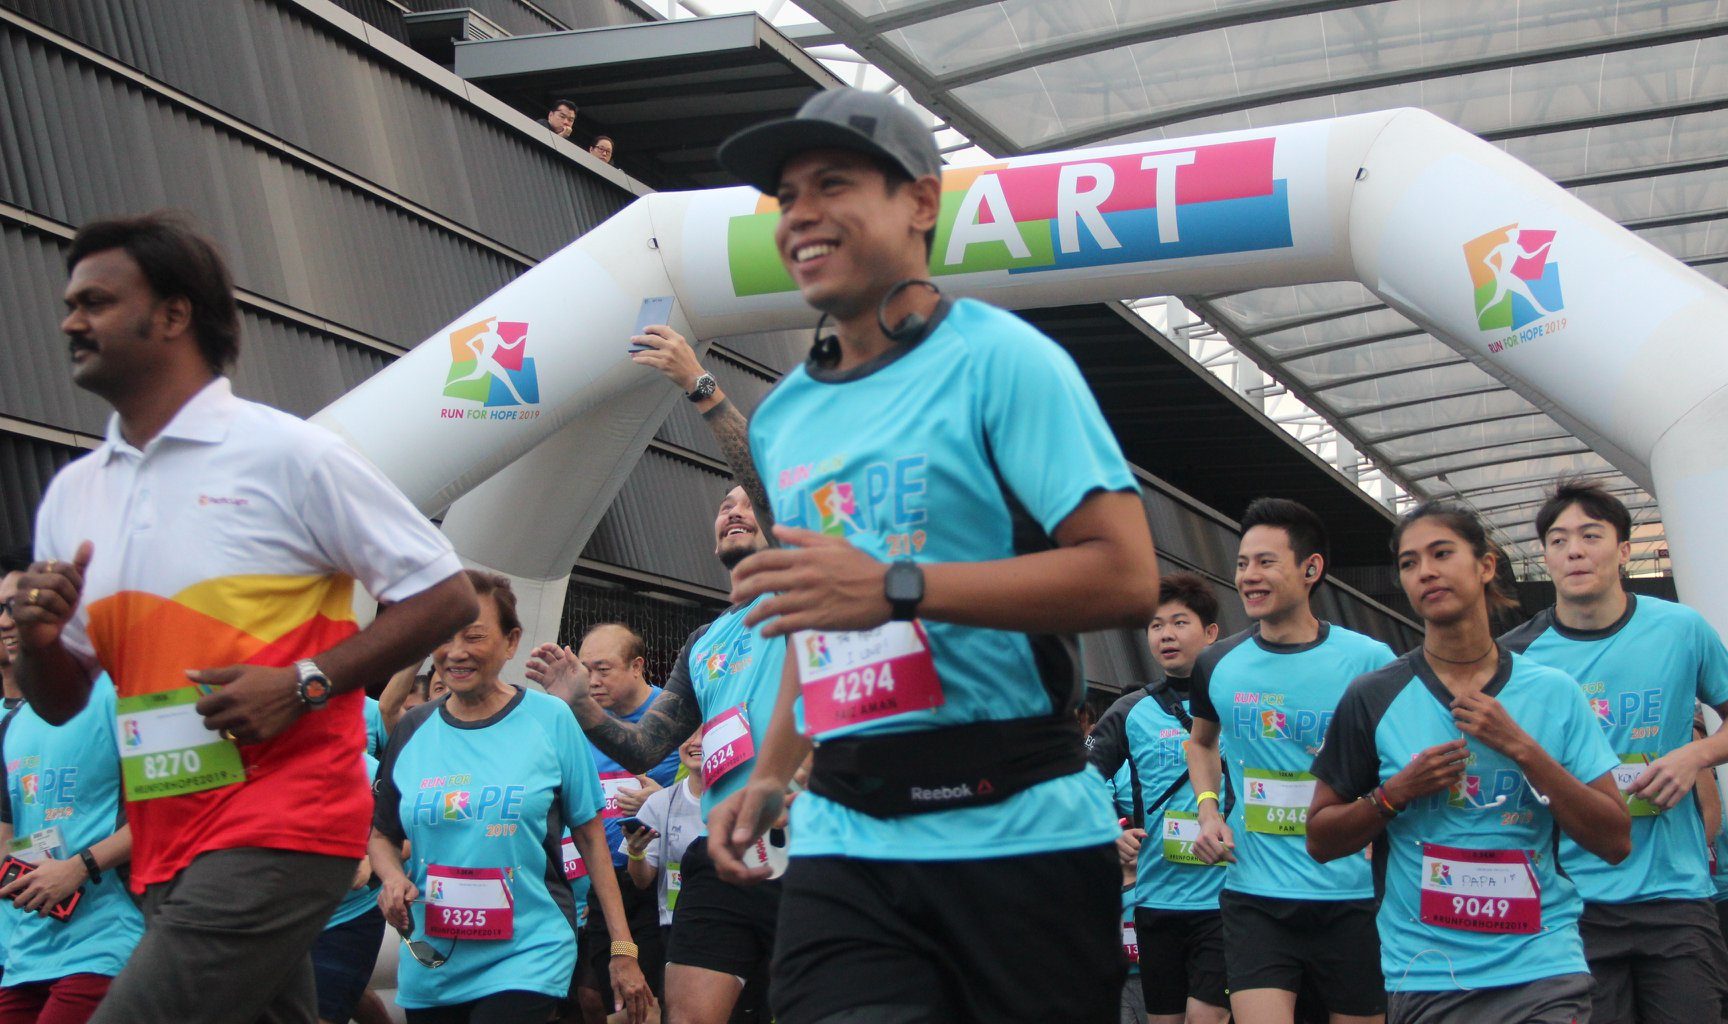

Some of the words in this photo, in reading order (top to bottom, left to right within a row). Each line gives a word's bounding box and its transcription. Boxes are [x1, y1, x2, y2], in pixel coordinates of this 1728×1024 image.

[944, 150, 1197, 266] ART
[1488, 340, 1504, 354] RUN
[1504, 335, 1519, 349] FOR
[1520, 325, 1544, 343] HOPE
[1545, 318, 1567, 335] 2019
[440, 408, 464, 419] RUN
[467, 409, 488, 420] FOR
[490, 410, 518, 420] HOPE
[519, 410, 540, 420] 2019
[777, 453, 929, 536] HPE
[832, 661, 895, 704] 4294
[1234, 692, 1260, 705] RUN
[1261, 693, 1285, 706] FOR
[1619, 688, 1662, 727] PE
[1232, 706, 1335, 744] HPE
[1631, 726, 1660, 740] 2019
[144, 749, 201, 780] 8270
[706, 743, 735, 774] 9324
[420, 776, 446, 789] RUN
[448, 774, 472, 786] FOR
[911, 783, 974, 800] Reebok
[413, 785, 526, 826] HPE
[1266, 807, 1307, 823] 6946
[485, 824, 517, 837] 2019
[1462, 874, 1496, 889] PAPA
[1452, 896, 1509, 918] 9049
[442, 909, 487, 927] 9325
[1433, 914, 1528, 930] #RUNFORHOPE2019
